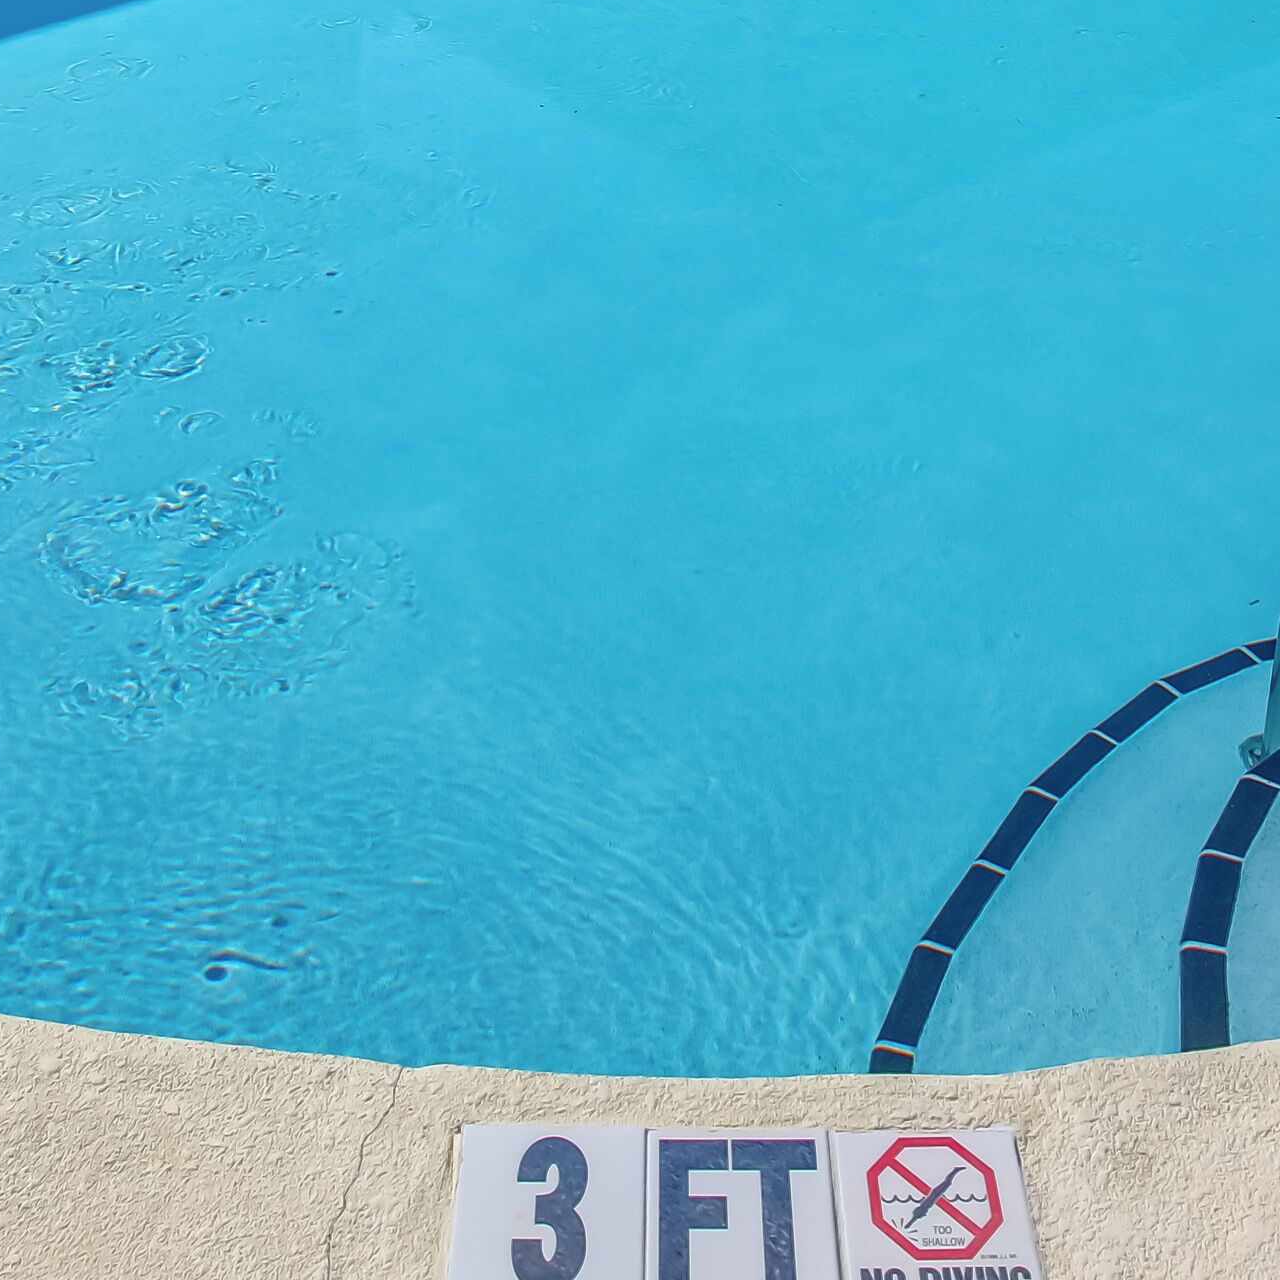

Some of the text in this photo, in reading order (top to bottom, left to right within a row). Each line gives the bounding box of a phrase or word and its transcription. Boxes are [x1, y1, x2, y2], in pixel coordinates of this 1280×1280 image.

[511, 1135, 818, 1280] 3 FT
[932, 1226, 953, 1235] TOO
[922, 1236, 966, 1246] SHALLOW
